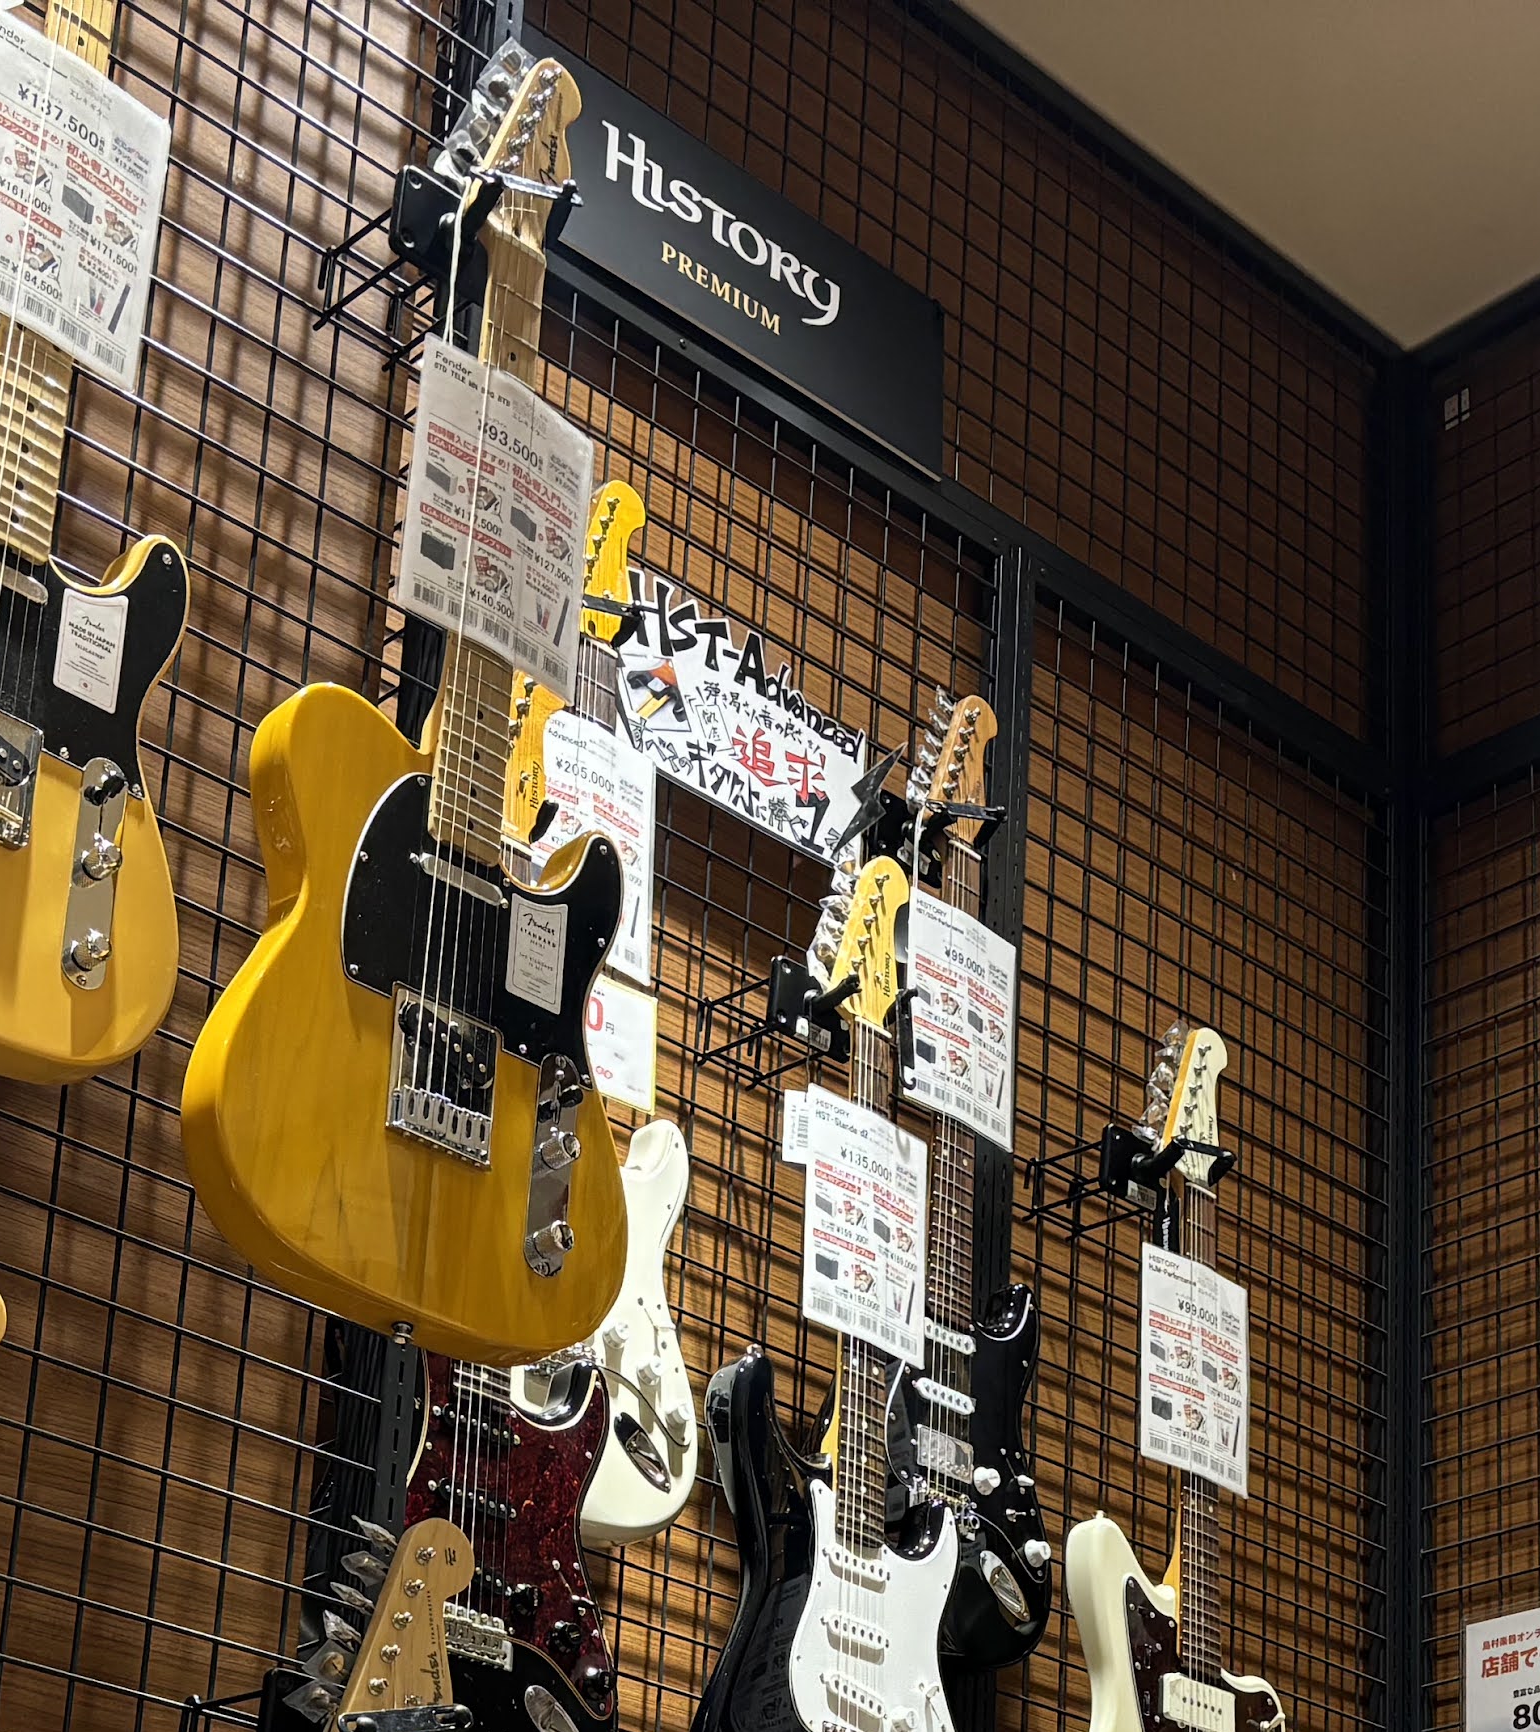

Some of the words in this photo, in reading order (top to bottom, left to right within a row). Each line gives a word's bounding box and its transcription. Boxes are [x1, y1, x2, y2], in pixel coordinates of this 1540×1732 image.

[18, 84, 106, 150] ¥137,500
[602, 119, 841, 326] HISTORY
[661, 241, 780, 336] PREMIUM
[435, 350, 473, 377] Fender
[477, 418, 540, 471] ¥93,500
[627, 567, 865, 764] HST-Advanced
[556, 755, 612, 793] ¥205,000
[732, 724, 827, 804] 追求
[1178, 1299, 1215, 1328] ¥99,000
